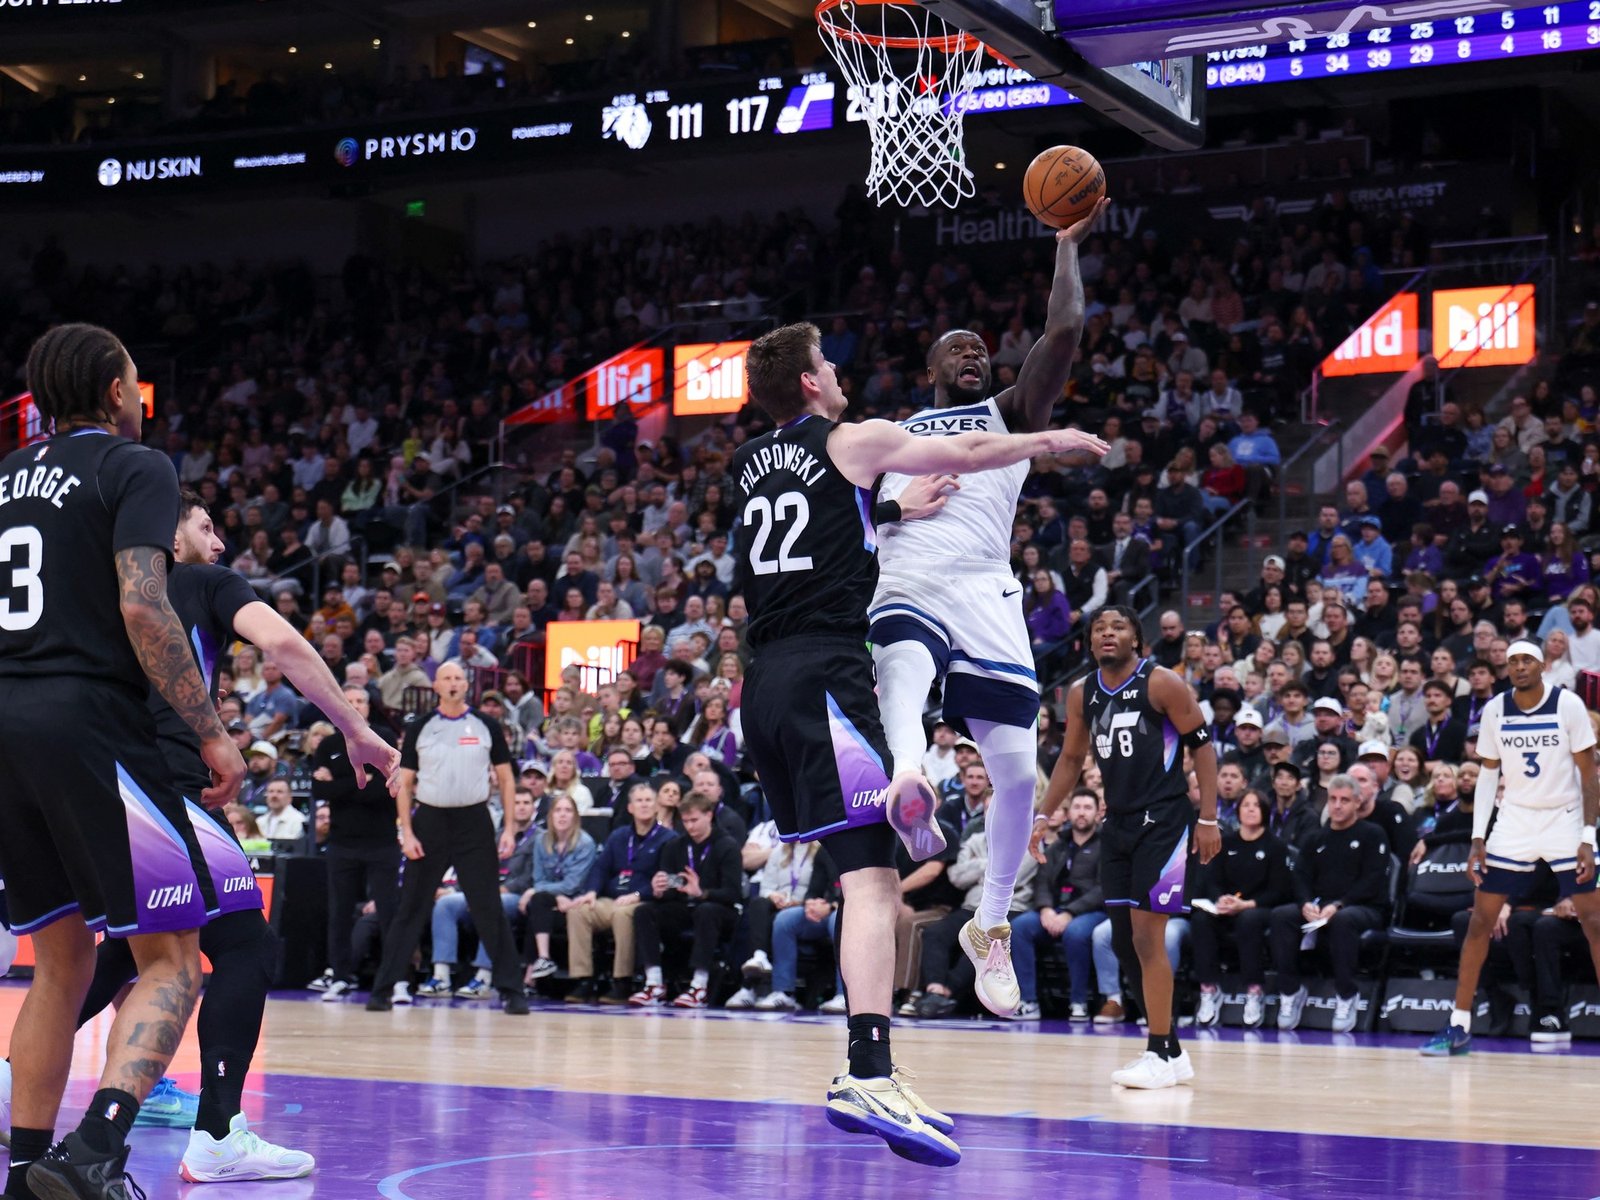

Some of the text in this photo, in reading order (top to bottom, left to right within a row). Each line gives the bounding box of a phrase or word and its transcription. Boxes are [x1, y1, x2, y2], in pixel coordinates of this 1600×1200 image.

[1327, 33, 1349, 48] 28
[1367, 28, 1391, 42] 42
[1410, 22, 1434, 39] 25
[1454, 16, 1474, 34] 12
[1501, 11, 1514, 29] 5
[1543, 6, 1559, 24] 11
[1220, 62, 1265, 85] (84%)
[1290, 58, 1303, 76] 5
[1326, 54, 1349, 72] 34
[1367, 50, 1391, 68] 39
[1410, 44, 1433, 64] 29
[1457, 40, 1471, 58] 8
[1501, 35, 1514, 53] 4
[1541, 30, 1561, 49] 16
[1587, 26, 1600, 44] 3
[1007, 85, 1050, 107] (56%)
[667, 102, 702, 140] 111
[726, 95, 769, 133] 117
[365, 132, 445, 160] PRYSM
[126, 156, 202, 181] NU SKIN
[1322, 187, 1394, 205] AERICA
[1398, 182, 1446, 199] FIRST
[1449, 302, 1519, 352] bill
[687, 355, 743, 401] bill
[905, 419, 988, 433] OLVES
[740, 443, 826, 495] FILIPOWSKI
[743, 491, 813, 575] 22
[0, 526, 44, 631] 3
[1122, 689, 1139, 699] LVT
[1118, 729, 1133, 757] 8
[1501, 735, 1560, 748] WOLVES
[1522, 752, 1541, 778] 3
[147, 883, 193, 909] UTAH
[223, 877, 254, 893] UTAH
